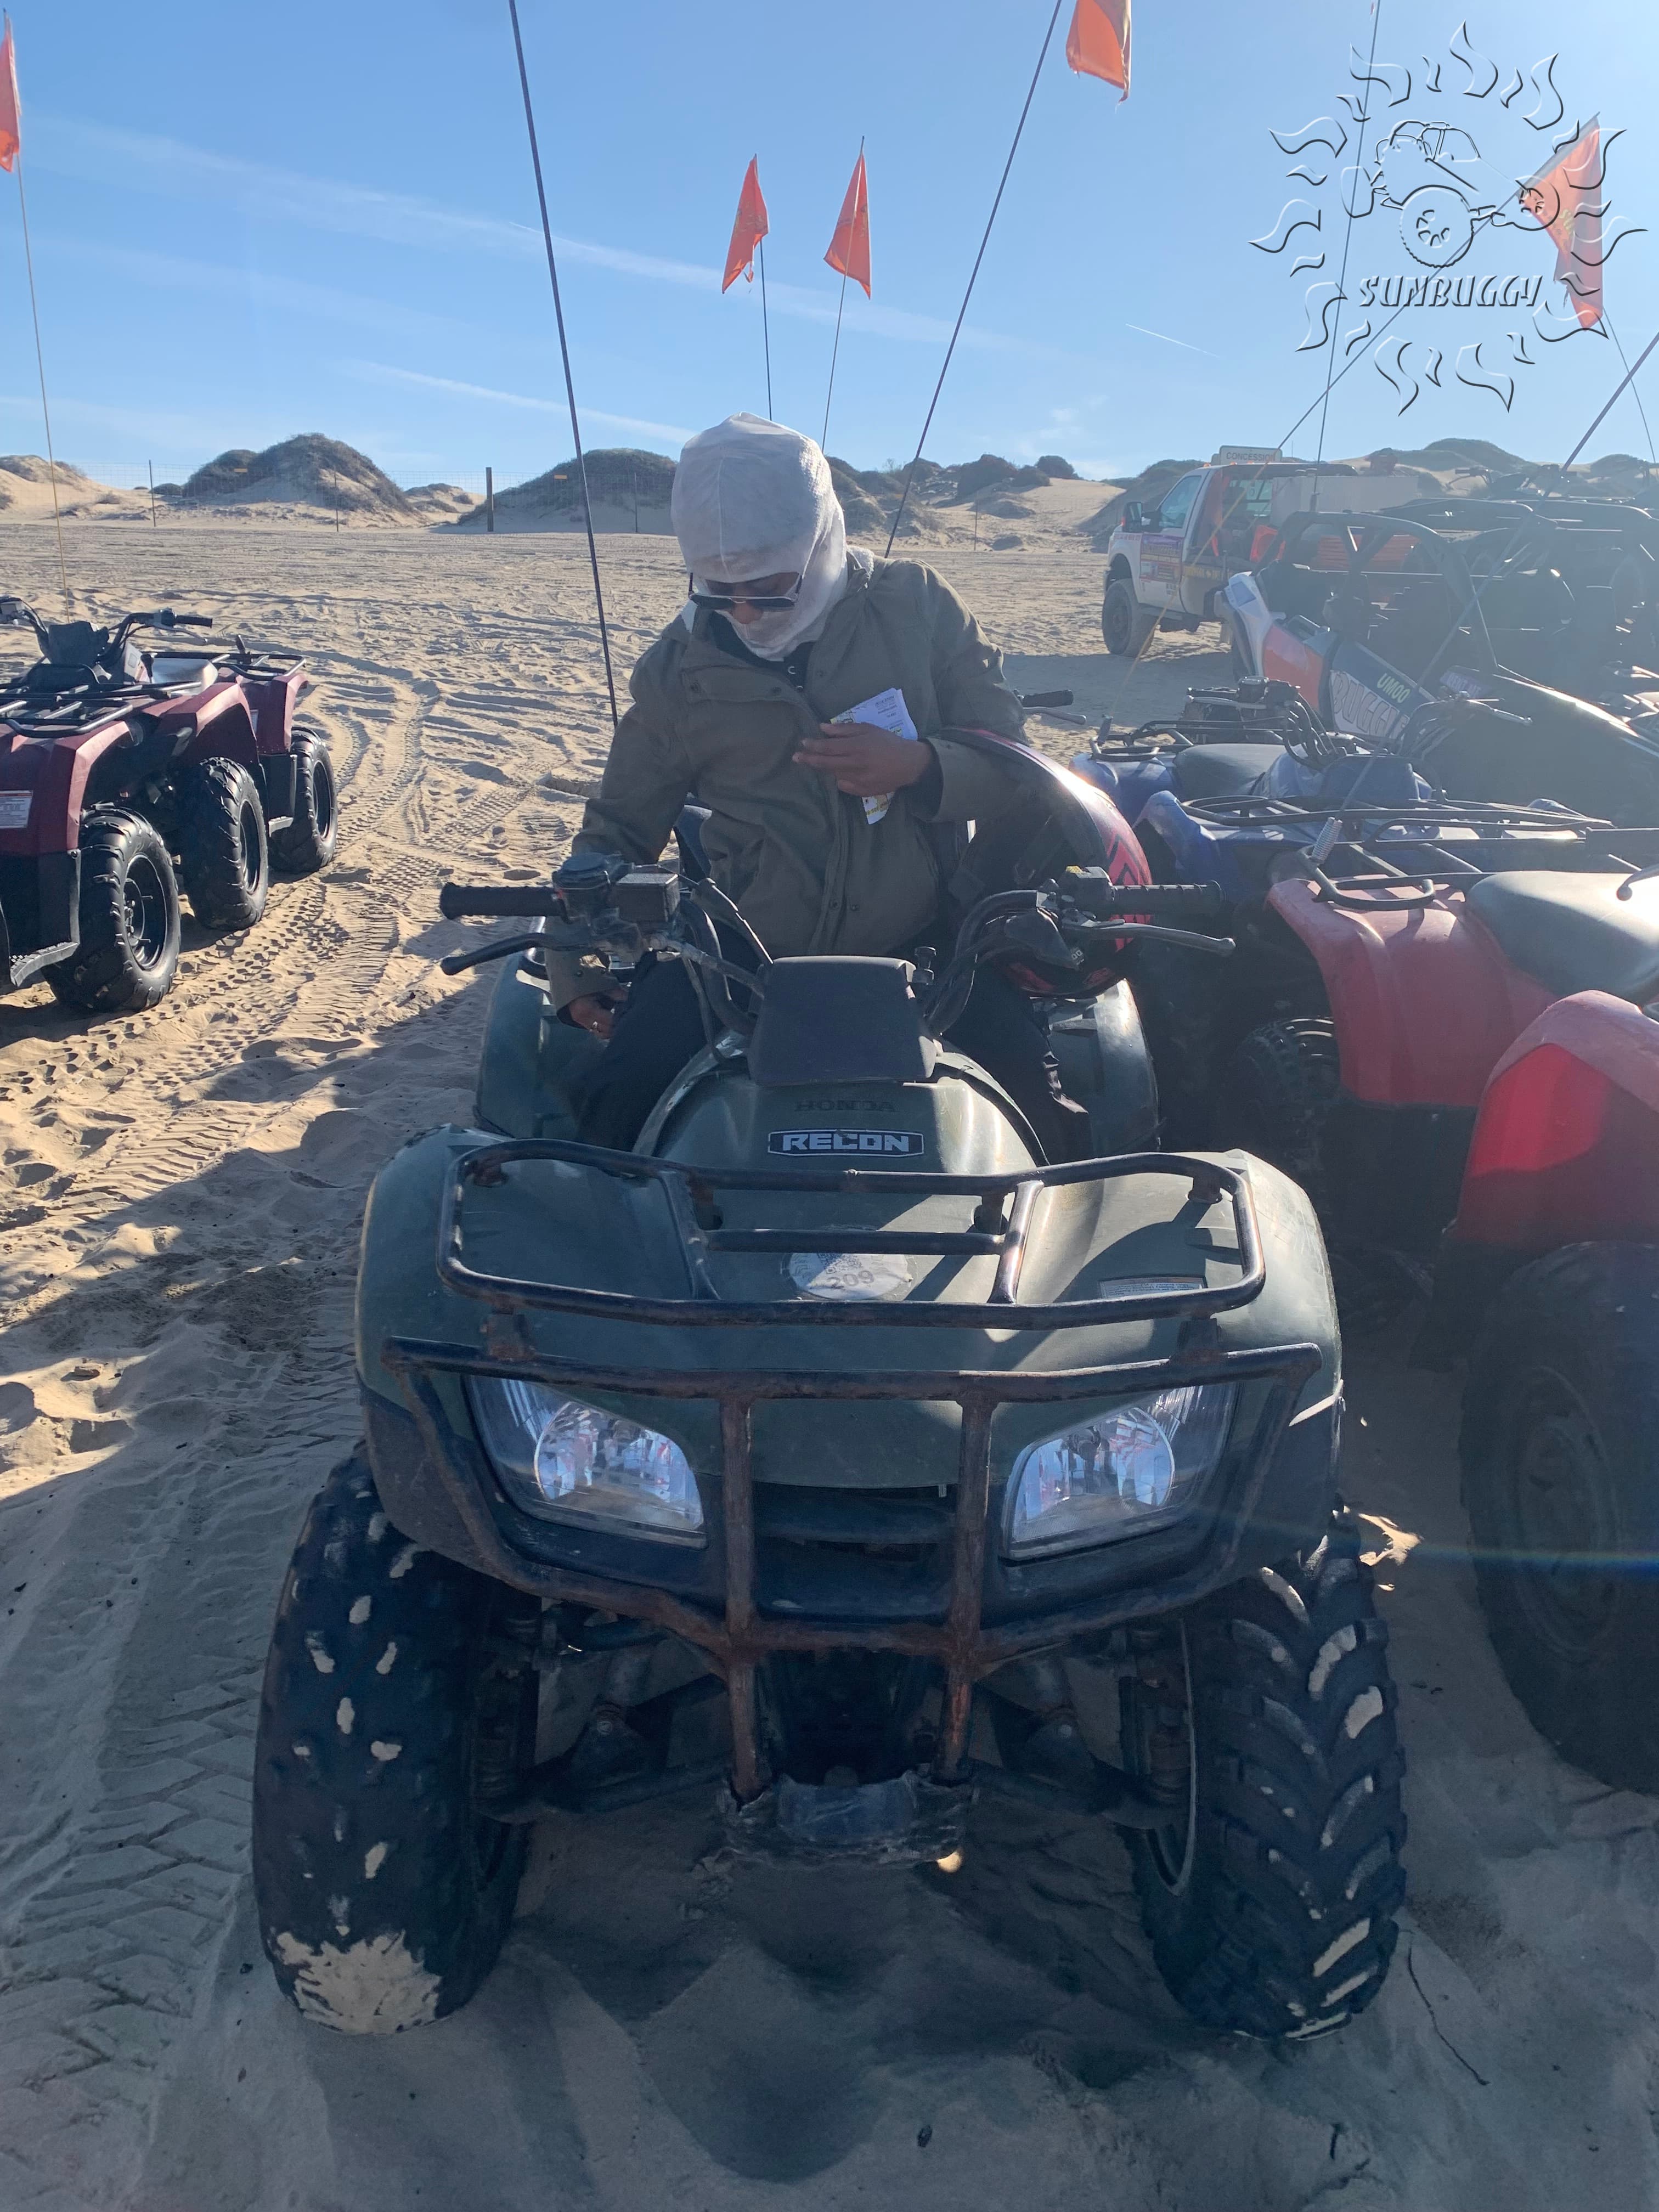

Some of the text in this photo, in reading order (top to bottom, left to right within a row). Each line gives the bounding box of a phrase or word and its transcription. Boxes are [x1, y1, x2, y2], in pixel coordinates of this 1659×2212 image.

[795, 1100, 899, 1113] HONDA
[782, 1133, 910, 1152] RECON
[826, 1269, 874, 1288] 209
